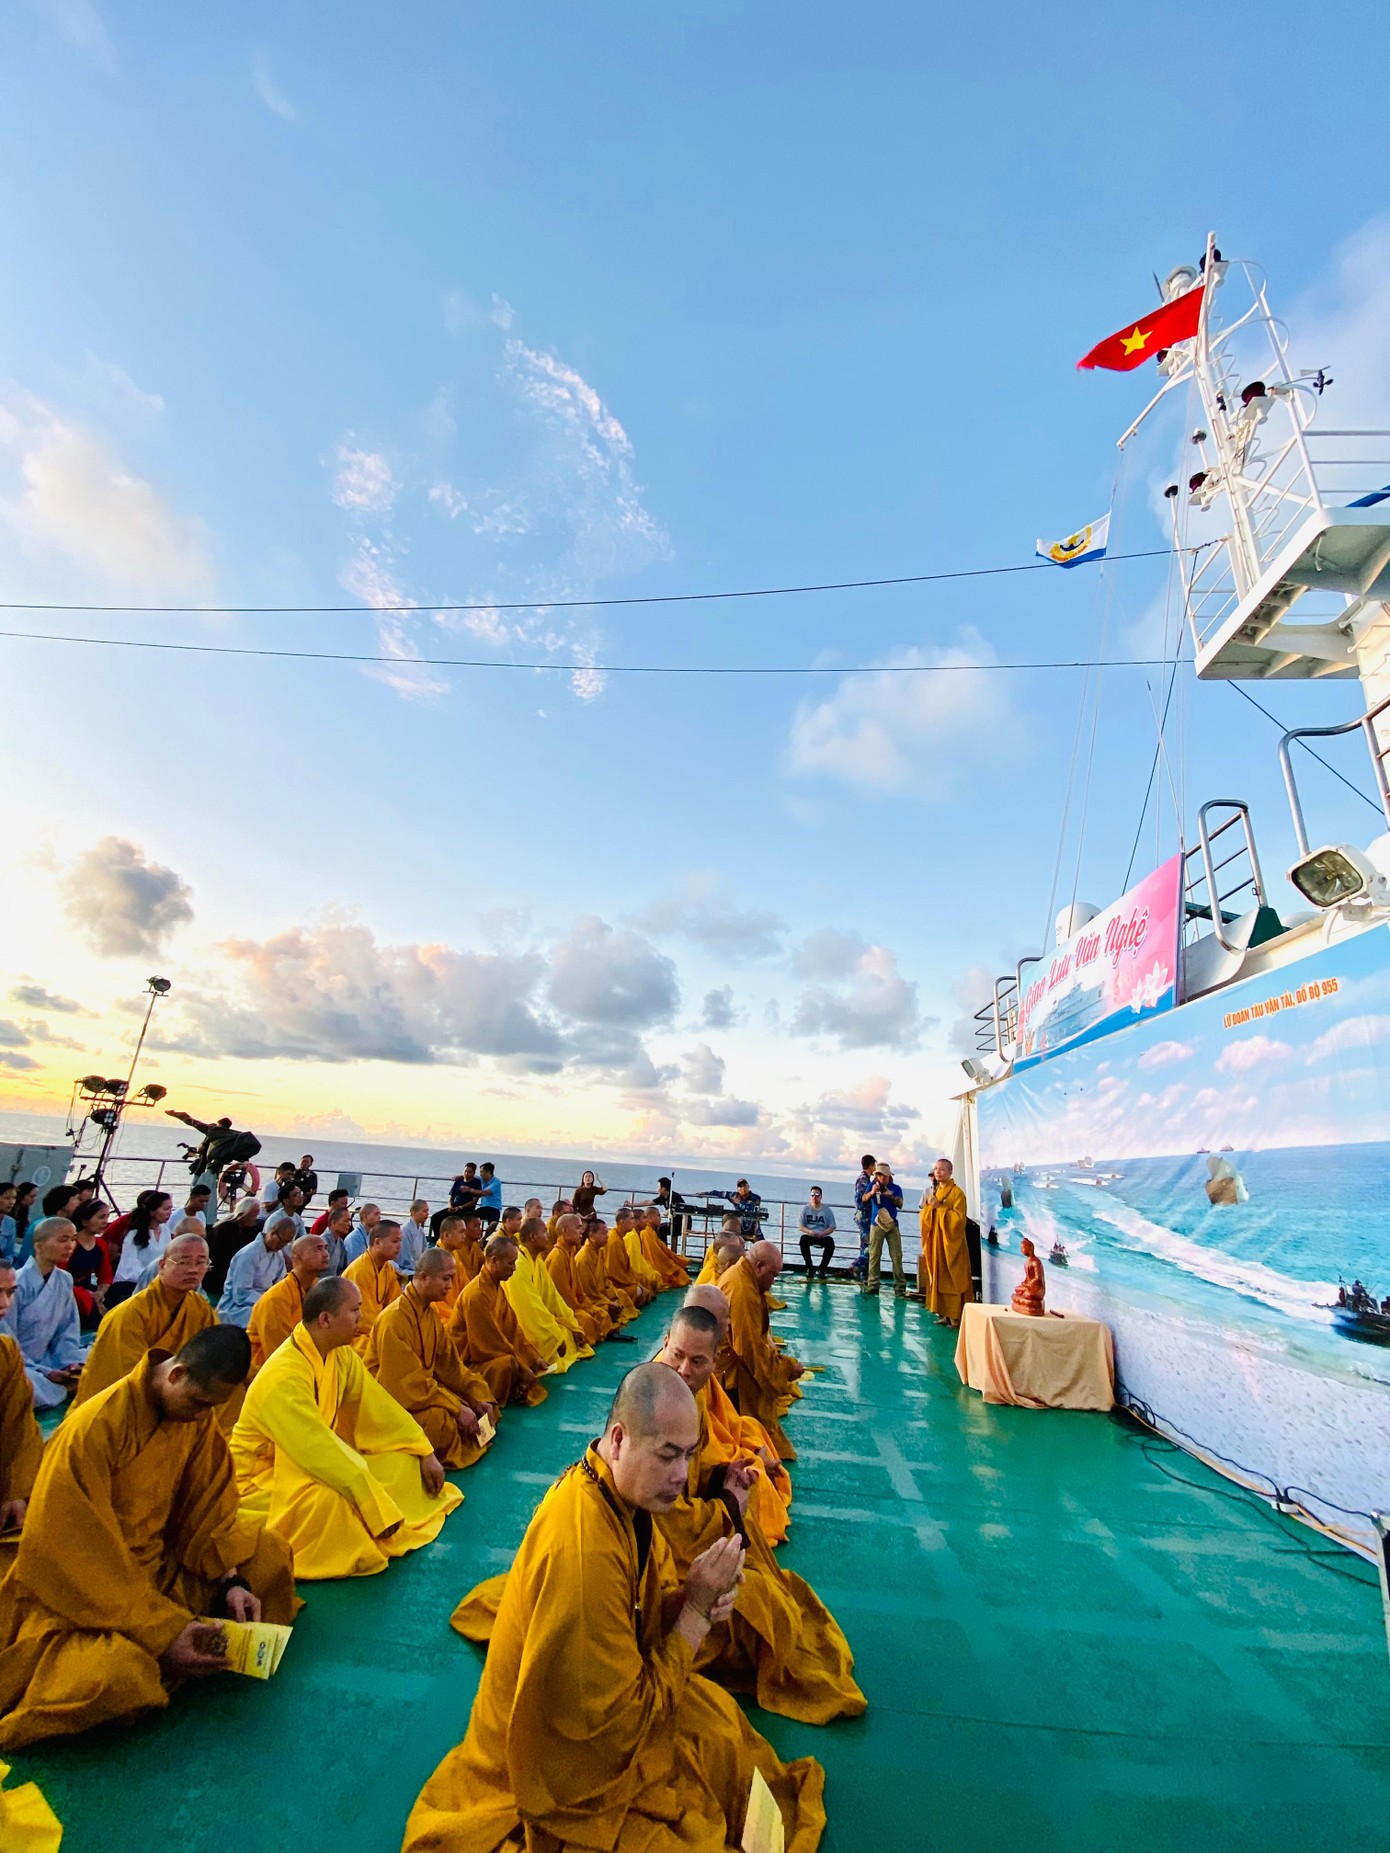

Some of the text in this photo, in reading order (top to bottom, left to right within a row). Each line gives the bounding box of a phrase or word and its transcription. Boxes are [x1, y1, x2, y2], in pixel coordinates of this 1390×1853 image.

[1026, 976, 1046, 1024] Giao
[1076, 931, 1101, 968] Văn
[1104, 907, 1148, 966] Nghệ
[1308, 981, 1320, 1001] BỘ
[1321, 978, 1339, 996] 955
